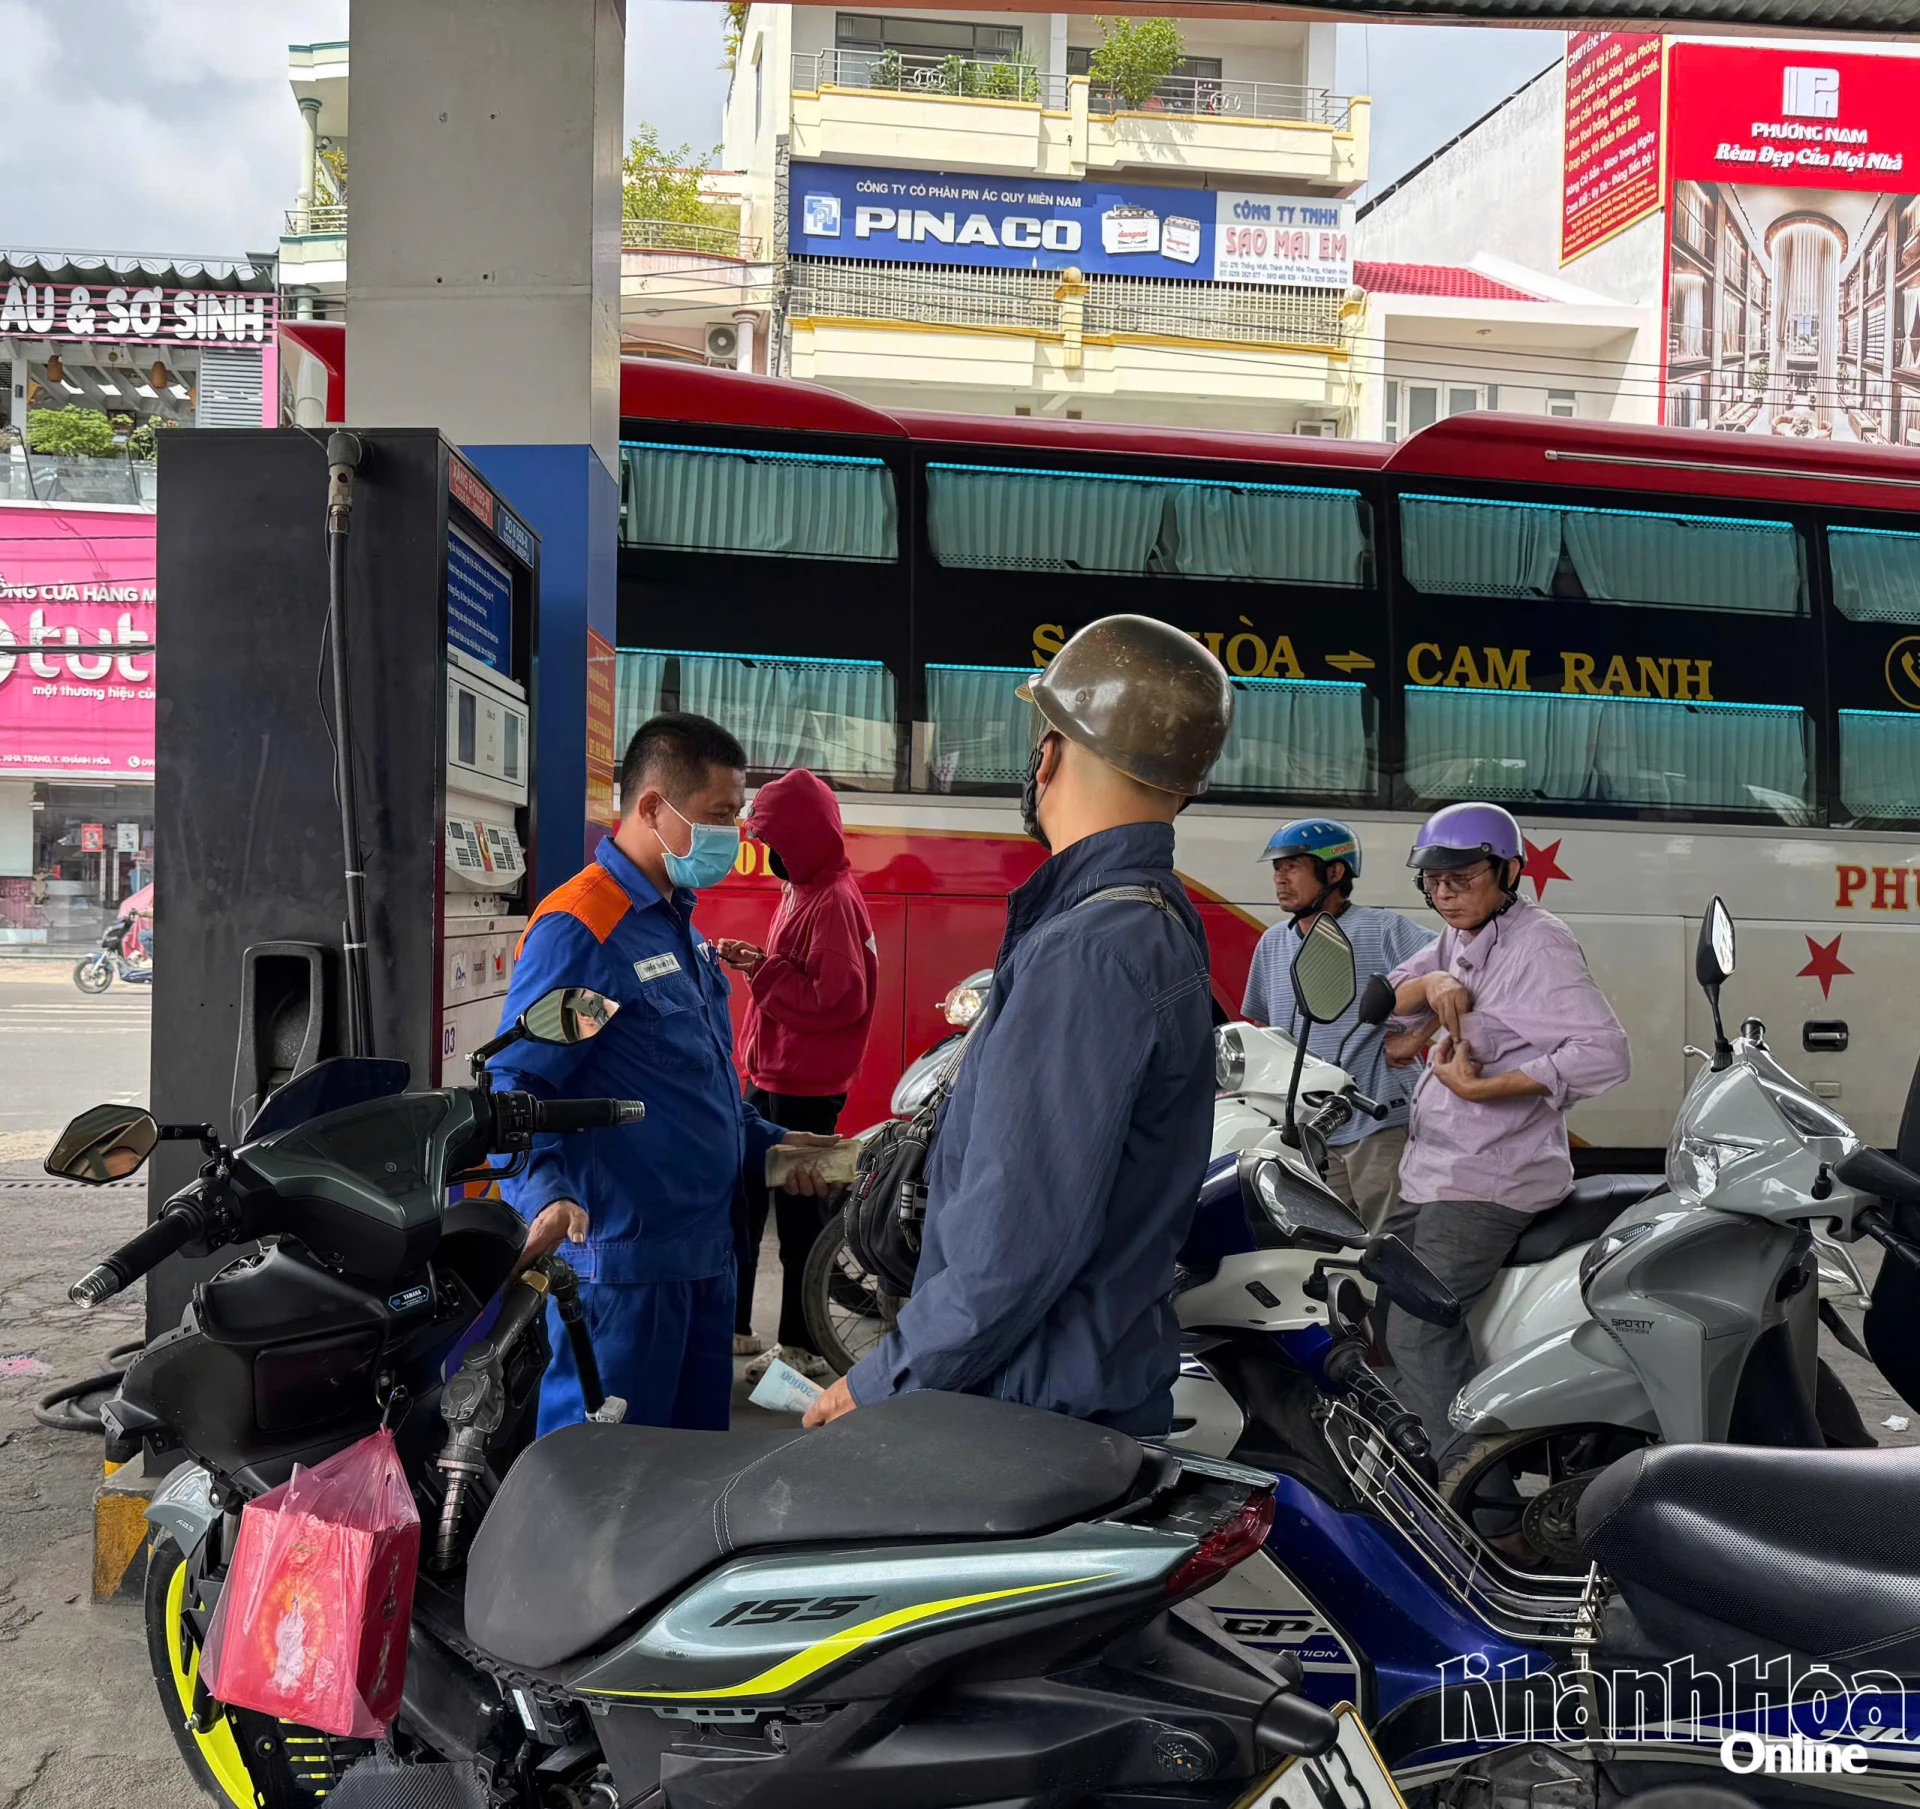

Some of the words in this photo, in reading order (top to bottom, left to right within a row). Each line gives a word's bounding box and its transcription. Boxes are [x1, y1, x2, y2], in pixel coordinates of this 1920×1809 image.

[1624, 96, 1637, 113] Spa
[1752, 122, 1823, 140] PHƯƠNG
[1825, 128, 1868, 144] NAM
[1603, 155, 1619, 171] Giao
[1619, 143, 1637, 161] Trong
[1637, 131, 1655, 149] Ngày
[1757, 145, 1795, 168] Đẹp
[1796, 147, 1830, 166] Của
[1831, 150, 1865, 172] Mọi
[856, 180, 889, 194] CÔNG
[891, 184, 907, 195] TY
[961, 189, 979, 200] PIN
[1001, 191, 1025, 204] QUY
[1056, 195, 1082, 208] NAM
[1233, 199, 1271, 221] CÔNG
[1277, 205, 1296, 224] TY
[1300, 207, 1338, 226] TNHH
[855, 206, 1082, 251] PINACO
[1226, 227, 1267, 257] SAO
[1274, 230, 1310, 260] MAI
[1319, 232, 1347, 261] EM
[66, 286, 97, 335] &
[106, 286, 164, 337] SƠ
[173, 291, 265, 342] SINH
[84, 582, 138, 601] HÀNG
[1406, 642, 1531, 690] CAM
[1560, 651, 1713, 700] RANH
[33, 686, 57, 700] một
[61, 685, 105, 700] thương
[108, 686, 135, 701] hiệu
[138, 686, 156, 699] củ
[1834, 863, 1920, 911] PH
[444, 1026, 455, 1055] 03
[1611, 1319, 1654, 1329] SPORTY
[708, 1595, 879, 1627] 155
[1222, 1618, 1313, 1637] GP
[1279, 1650, 1338, 1658] ITION
